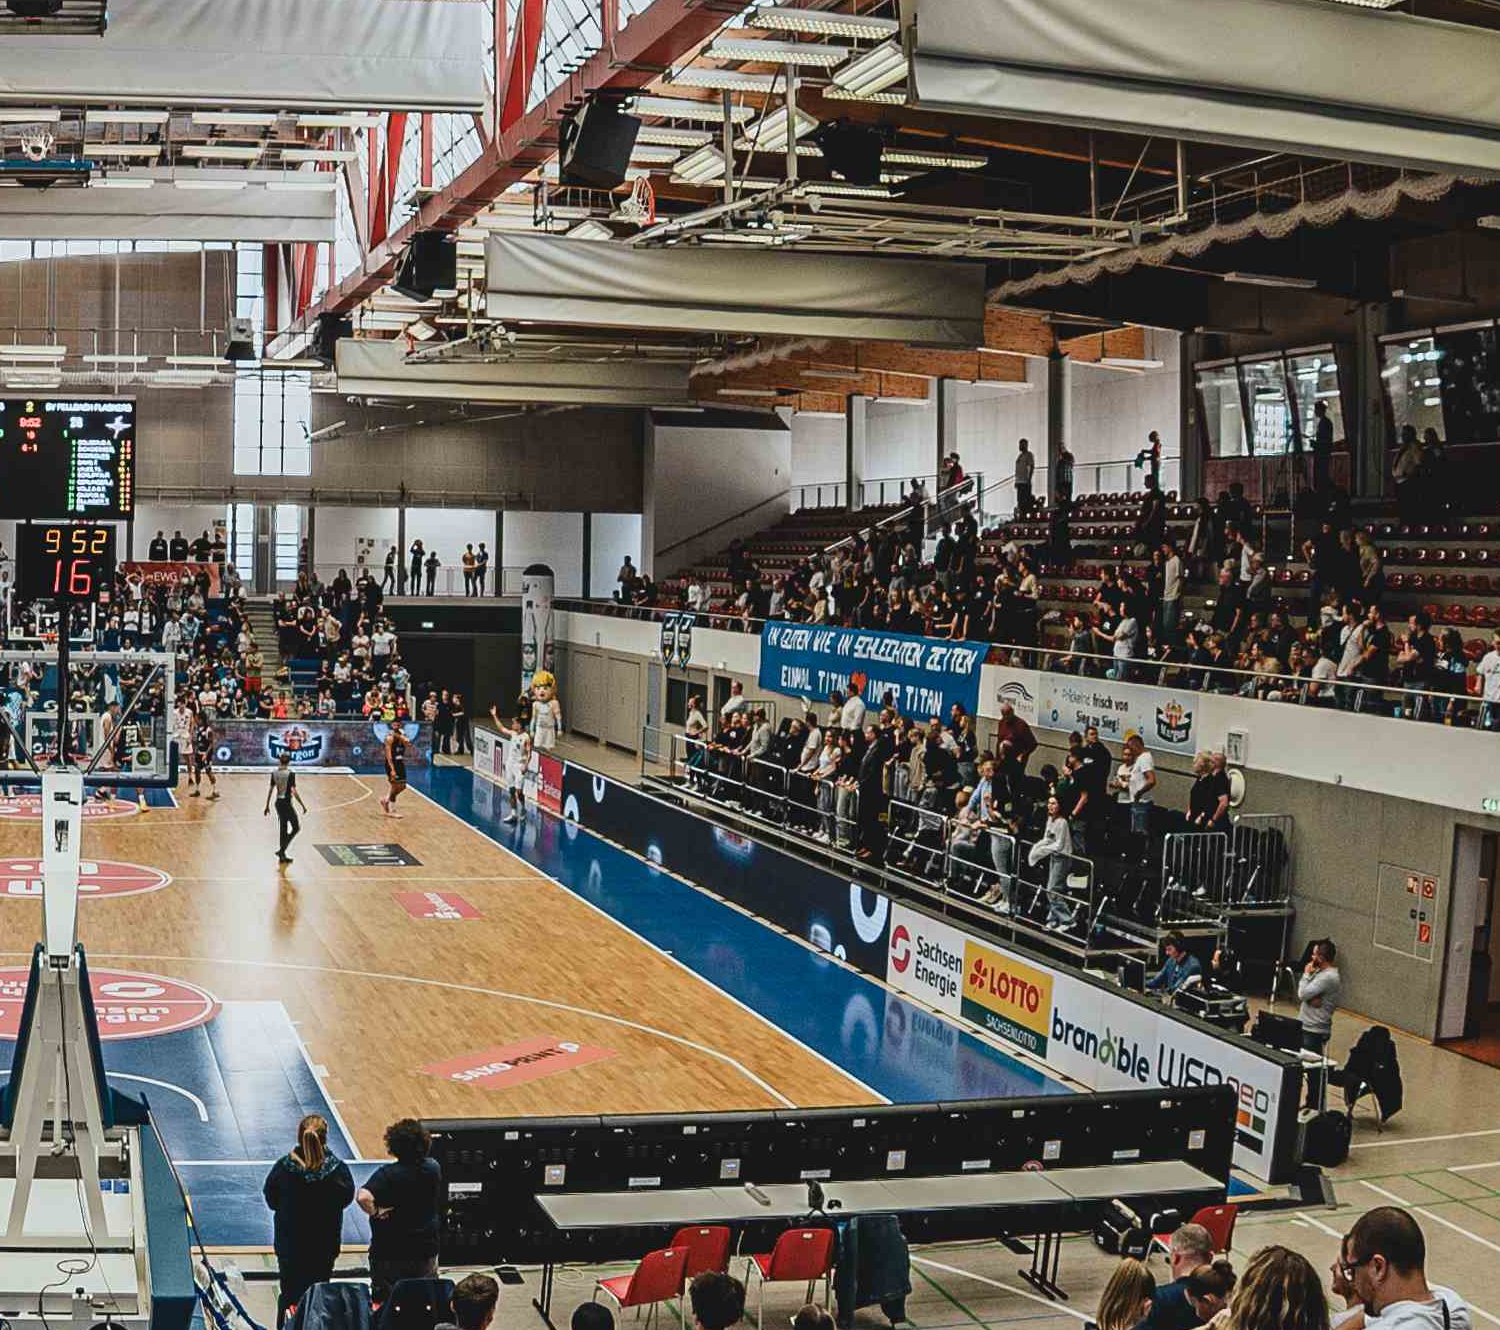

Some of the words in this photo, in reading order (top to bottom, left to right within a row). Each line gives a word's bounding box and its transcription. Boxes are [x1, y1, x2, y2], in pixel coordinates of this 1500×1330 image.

[45, 529, 61, 553] 9
[72, 530, 107, 554] 52
[53, 560, 92, 595] 16
[813, 631, 837, 654] WIE
[838, 635, 853, 657] IN
[853, 635, 926, 668] SCHLECHTEN
[926, 646, 979, 674] ZEITEN
[818, 669, 849, 697] TITAN
[906, 685, 943, 716] TITAN
[1092, 694, 1113, 709] frisch
[1114, 700, 1129, 712] von
[275, 747, 315, 761] Mrgon
[916, 935, 963, 975] Sachsen
[914, 960, 957, 998] Energie
[989, 967, 1040, 1014] LOTTO
[1052, 1007, 1150, 1083] brandible
